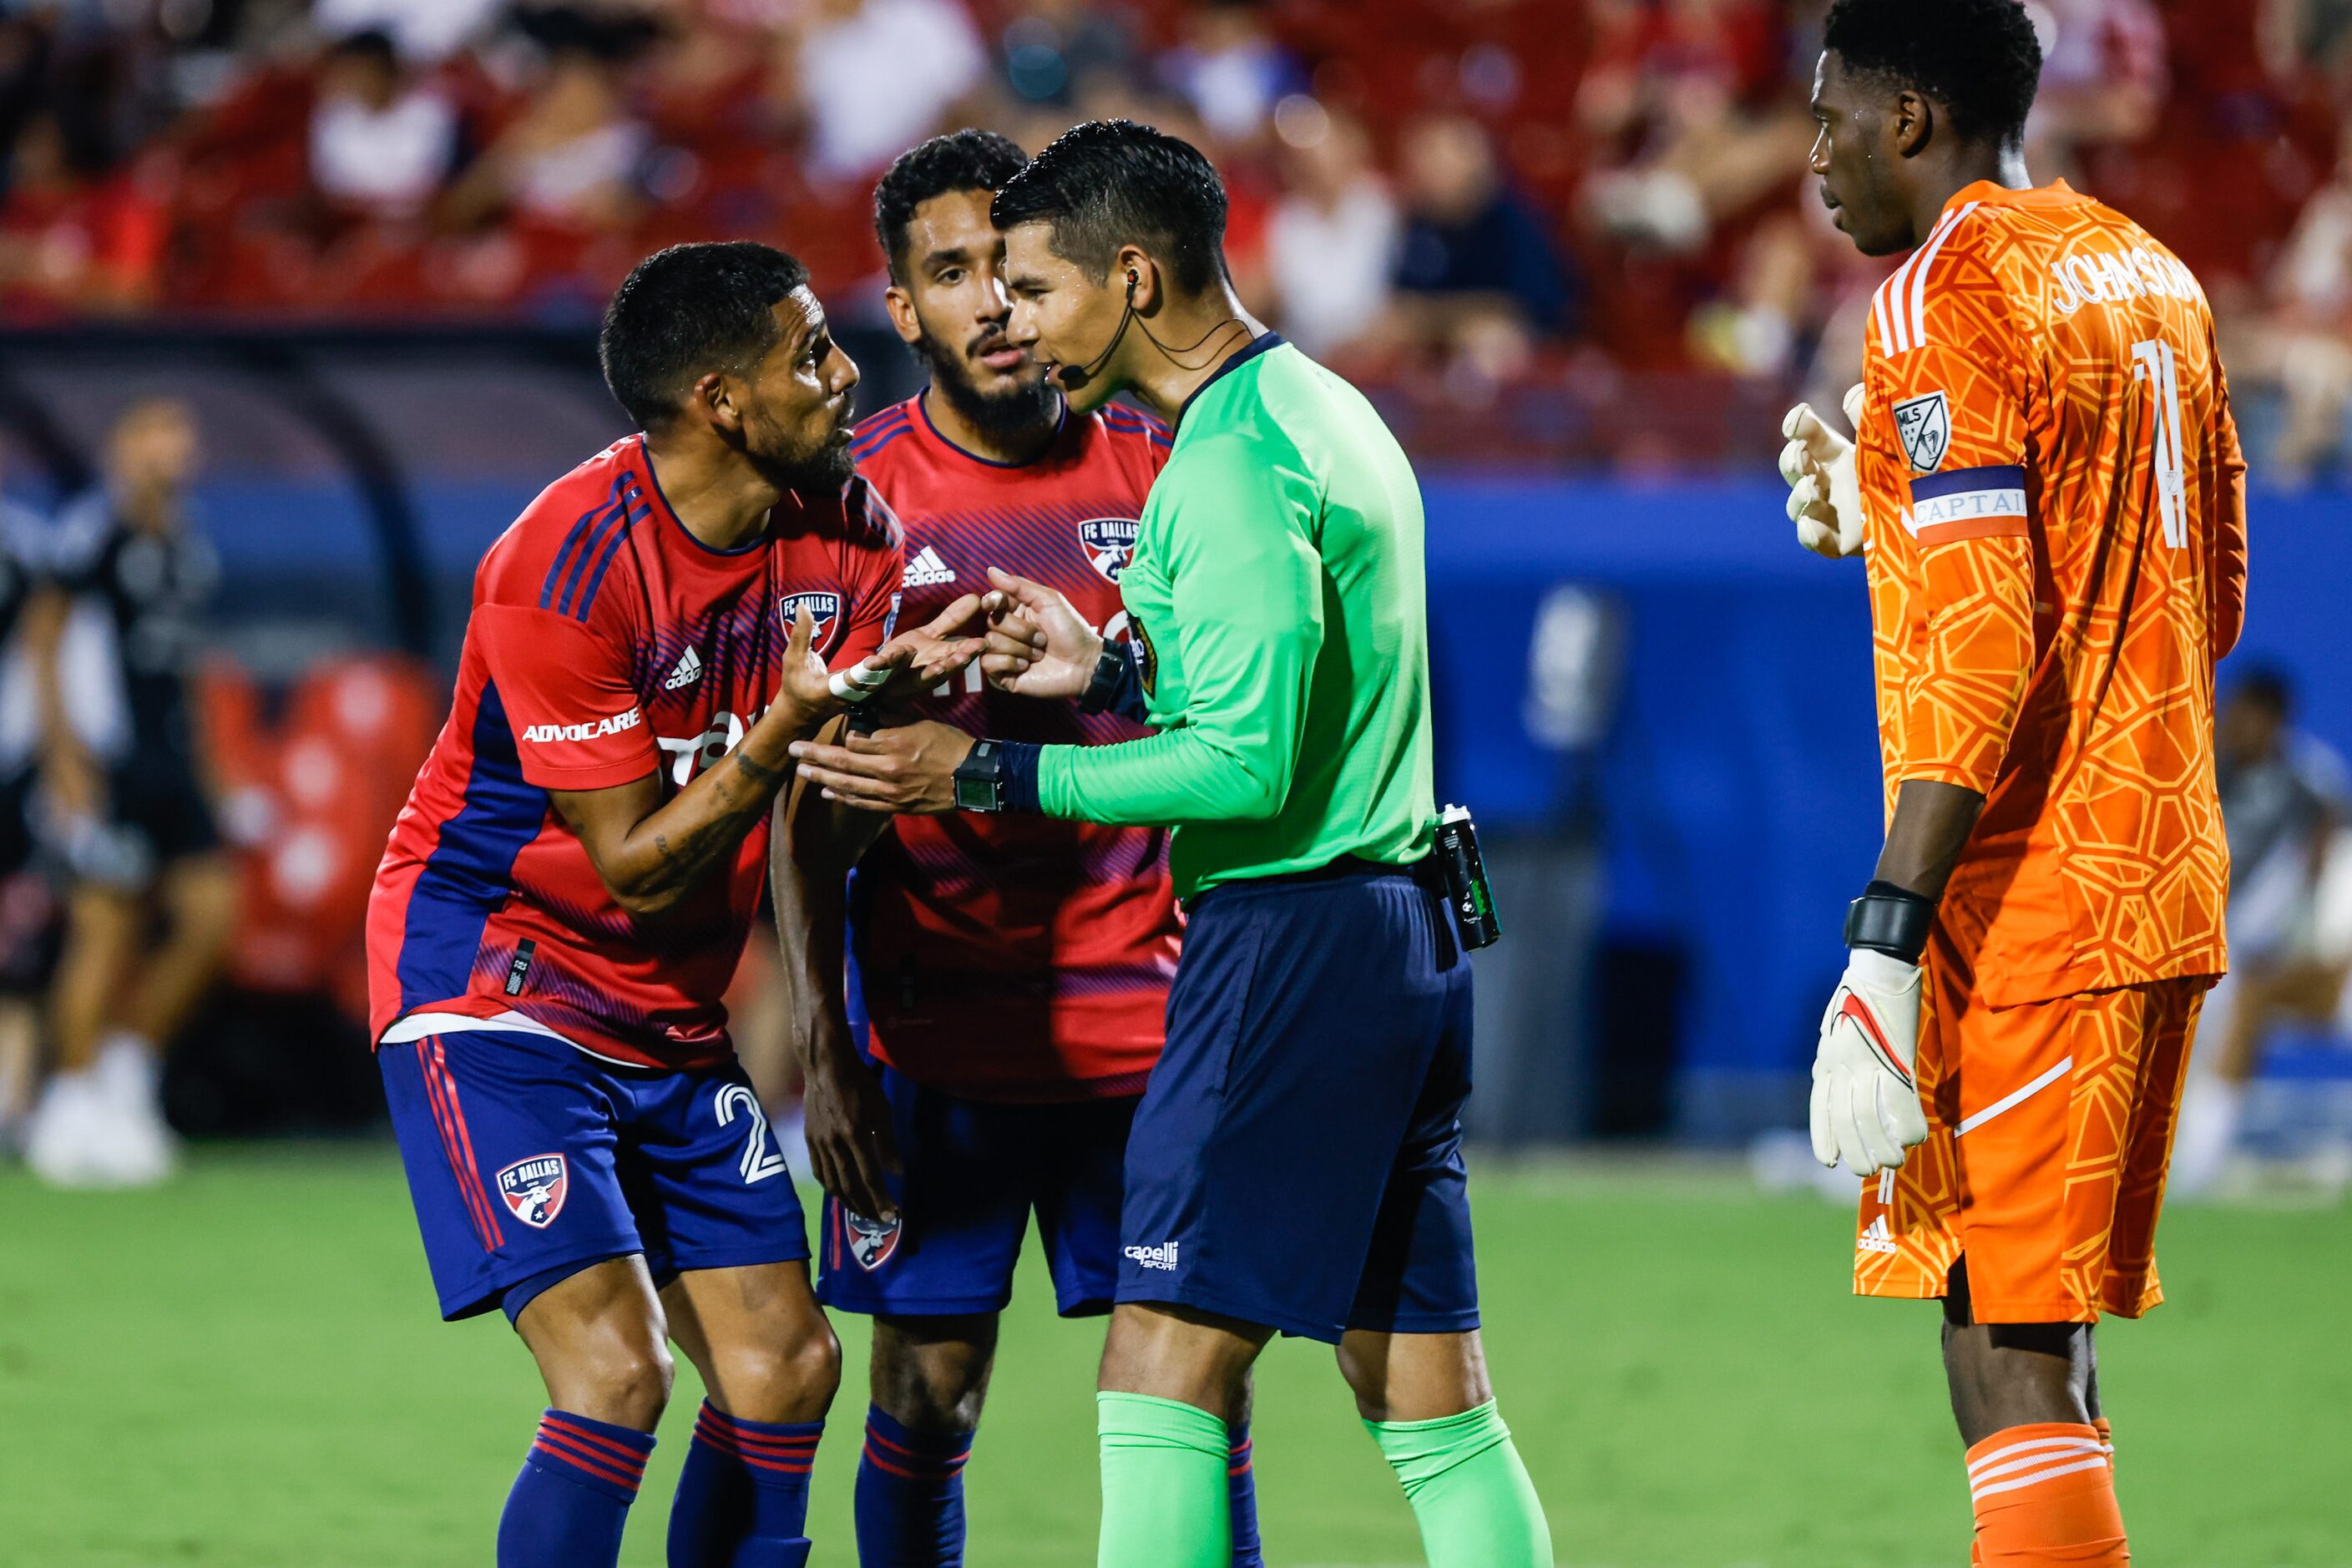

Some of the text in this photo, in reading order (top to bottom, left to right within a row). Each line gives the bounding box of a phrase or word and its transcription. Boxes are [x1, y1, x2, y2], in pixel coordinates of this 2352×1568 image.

[2050, 247, 2202, 314] JOHNSON
[1896, 407, 1921, 428] MLS
[2131, 338, 2188, 549] 1
[1916, 493, 2027, 524] CAPTAI
[1084, 524, 1098, 540] FC
[783, 599, 796, 617] FC
[665, 667, 703, 690] adida
[522, 706, 641, 742] ADVOCARE
[714, 1083, 787, 1185] 2
[503, 1160, 559, 1190] FC DALLAS
[1124, 1242, 1179, 1265] capelli
[1143, 1261, 1178, 1272] SPORT
